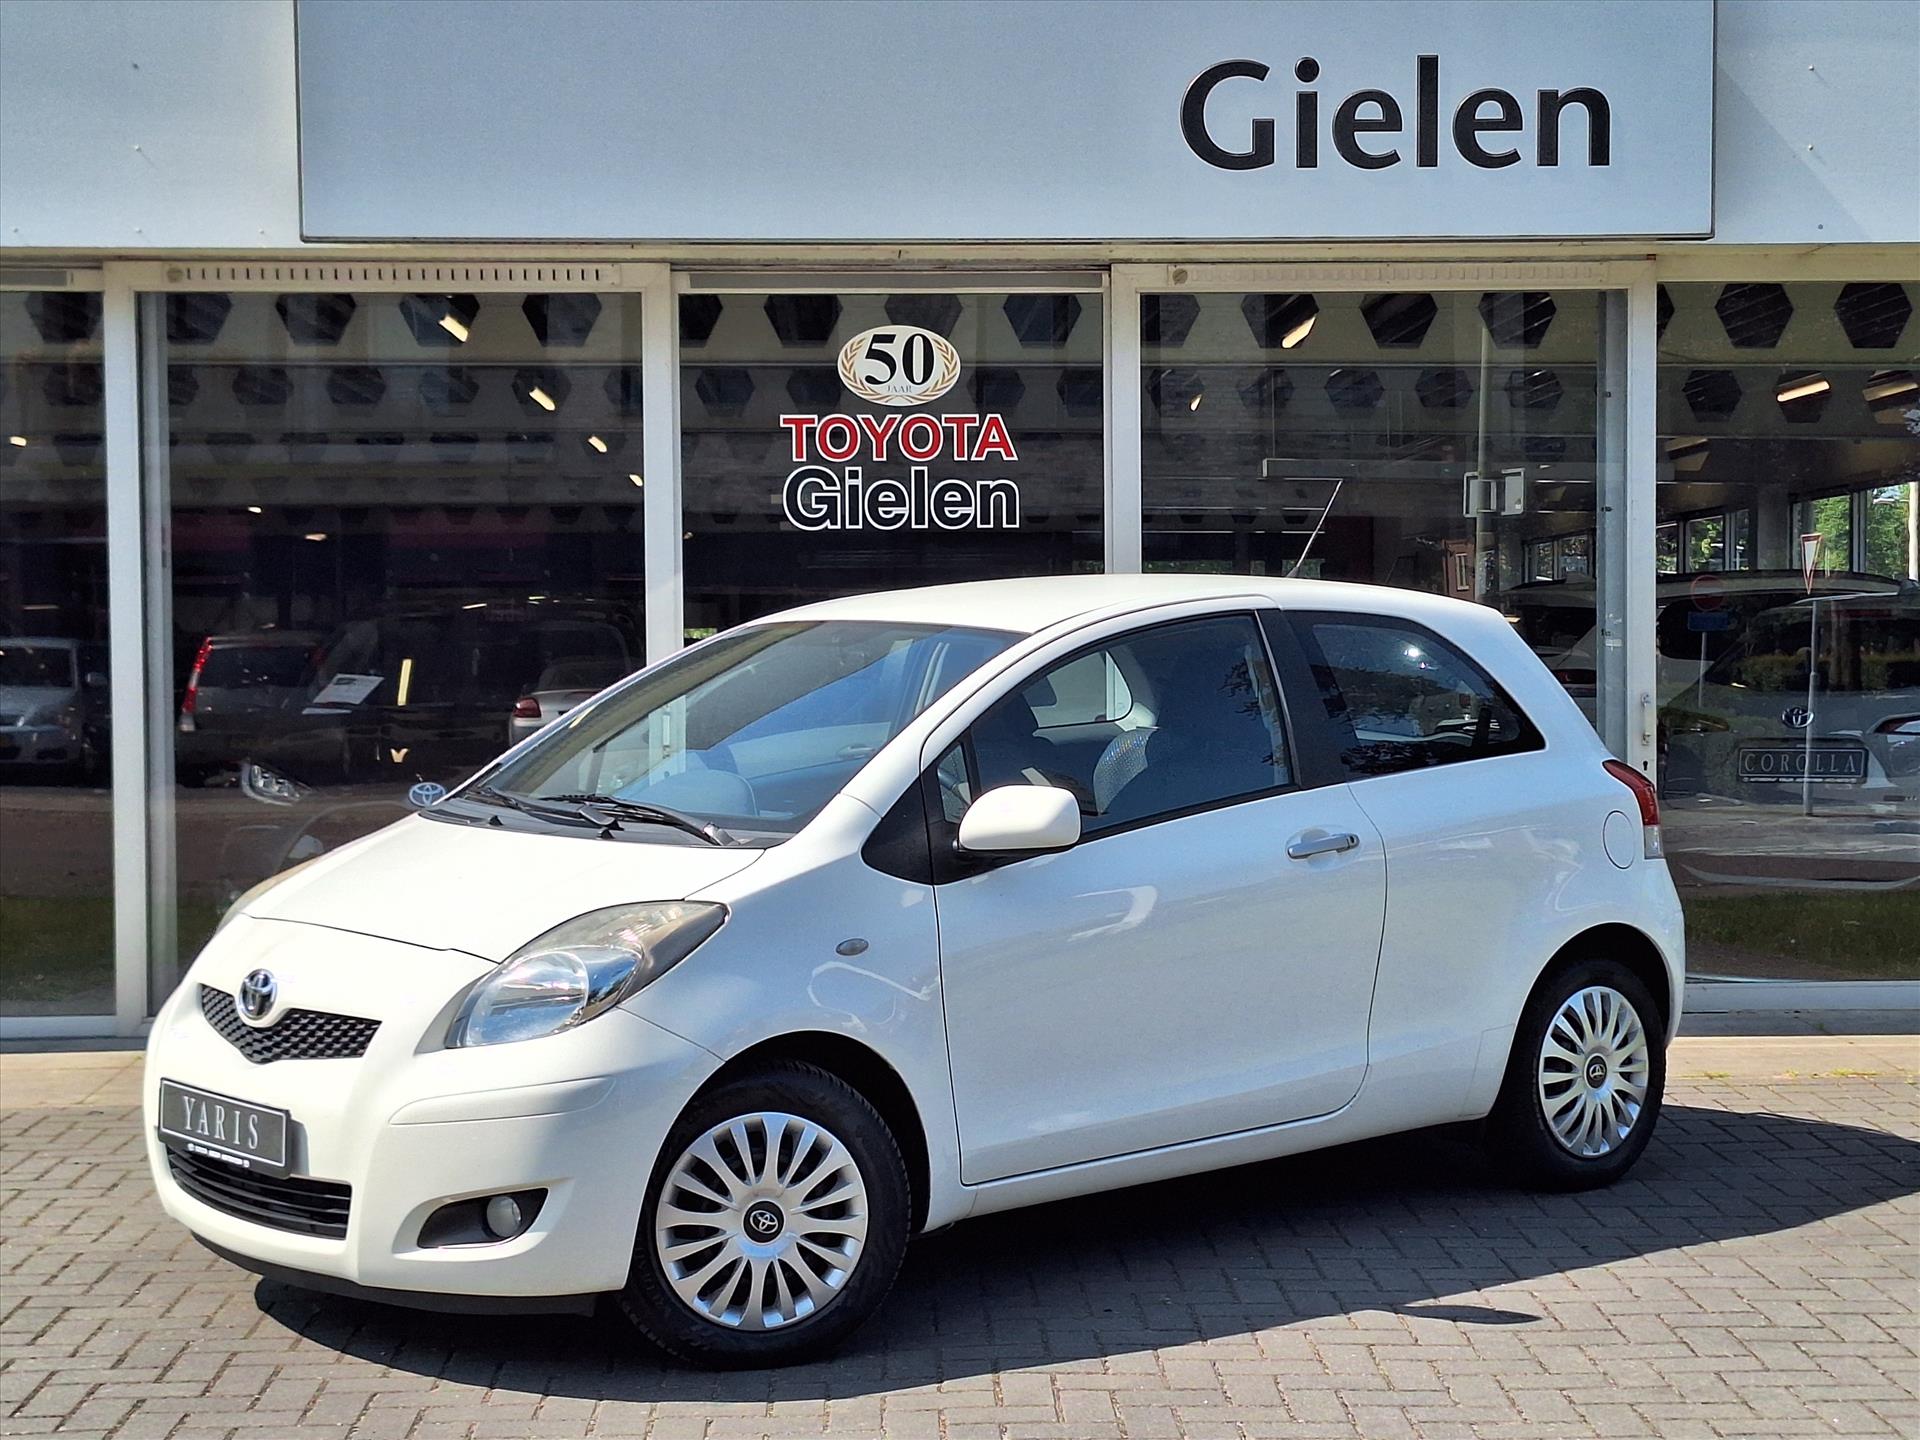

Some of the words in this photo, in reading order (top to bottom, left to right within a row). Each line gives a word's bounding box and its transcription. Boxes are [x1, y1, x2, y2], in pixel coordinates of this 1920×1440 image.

[1180, 54, 1611, 170] Gielen
[864, 333, 935, 385] 50
[780, 414, 1018, 462] TOYOTA
[783, 465, 1020, 531] Gielen
[1744, 753, 1856, 773] COROLLA
[183, 1095, 258, 1150] YARIS
